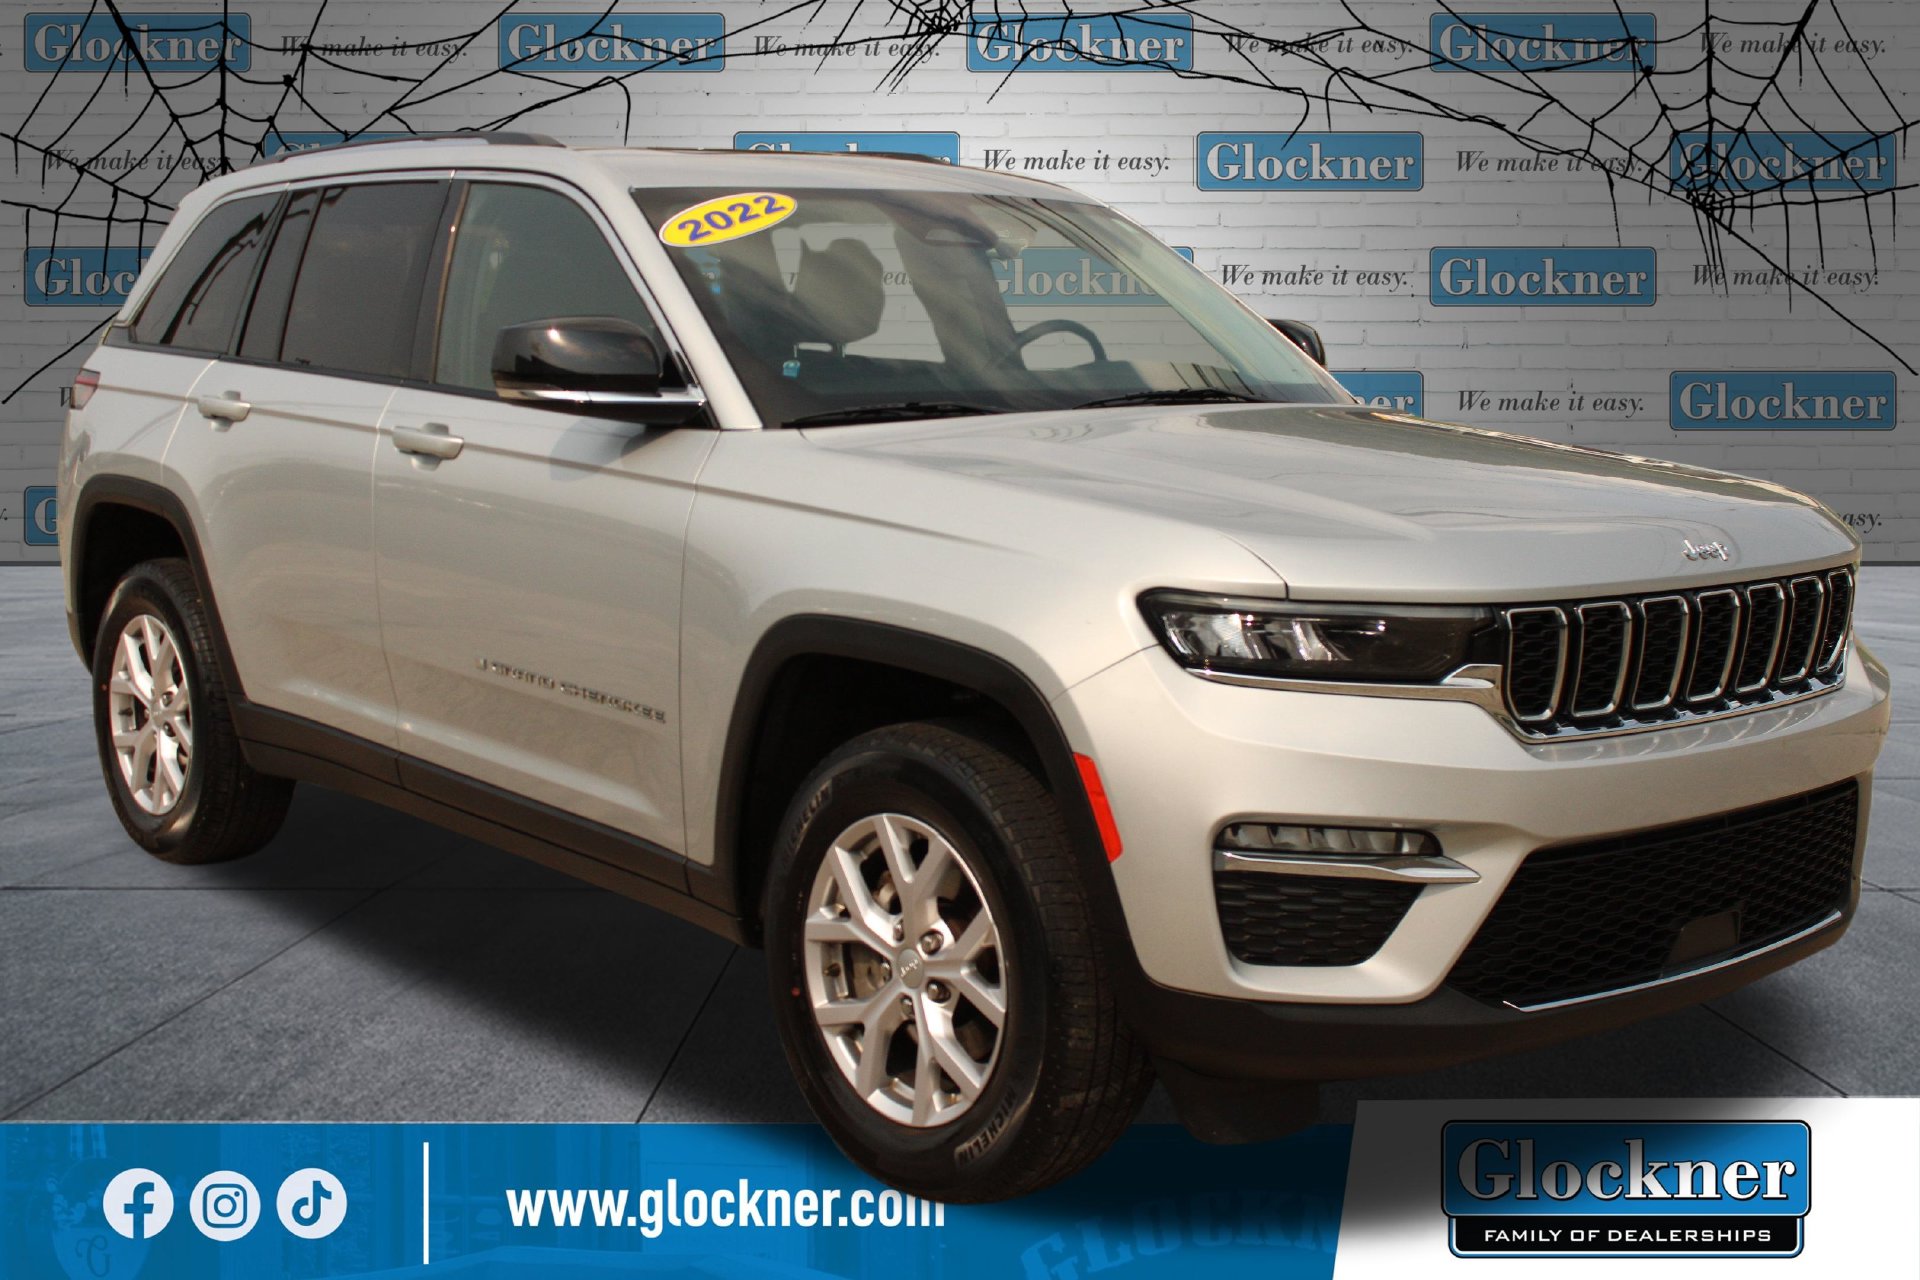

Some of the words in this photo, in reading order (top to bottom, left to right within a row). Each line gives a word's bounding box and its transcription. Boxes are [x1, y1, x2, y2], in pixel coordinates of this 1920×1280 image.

[34, 23, 243, 62] Glockner
[322, 35, 383, 57] make
[391, 35, 408, 57] it
[415, 43, 467, 63] easy.
[508, 23, 717, 62] Glockner
[754, 35, 787, 57] We
[794, 35, 856, 57] make
[864, 37, 881, 57] it
[976, 23, 1185, 62] Glockner
[1227, 32, 1260, 54] We
[1337, 34, 1354, 54] it
[1361, 39, 1413, 60] easy.
[1439, 23, 1648, 62] Glockner
[1700, 32, 1733, 54] We
[1740, 32, 1800, 54] make
[1810, 32, 1828, 54] it
[1834, 39, 1886, 60] easy.
[47, 149, 80, 171] We
[86, 149, 149, 171] make
[156, 149, 173, 171] it
[983, 149, 1016, 171] We
[1023, 149, 1086, 171] make
[1093, 149, 1111, 171] it
[1117, 156, 1170, 178] easy.
[1206, 142, 1415, 181] Glockner
[1456, 150, 1490, 173] We
[1496, 150, 1559, 173] make
[1566, 152, 1584, 173] it
[1679, 142, 1888, 181] Glockner
[677, 194, 788, 242] 2022
[1221, 264, 1255, 286] We
[1261, 264, 1324, 286] make
[1332, 264, 1348, 286] it
[1355, 271, 1408, 293] easy.
[1439, 257, 1648, 296] Glockner
[1692, 264, 1726, 286] We
[1733, 264, 1794, 286] make
[1802, 264, 1820, 286] it
[1826, 271, 1879, 293] easy.
[1458, 390, 1491, 412] We
[1498, 390, 1560, 412] make
[1568, 390, 1585, 412] it
[1592, 397, 1644, 419] easy.
[1679, 381, 1888, 421] Glockner
[1839, 511, 1883, 534] asy.
[1681, 539, 1729, 562] Jeep
